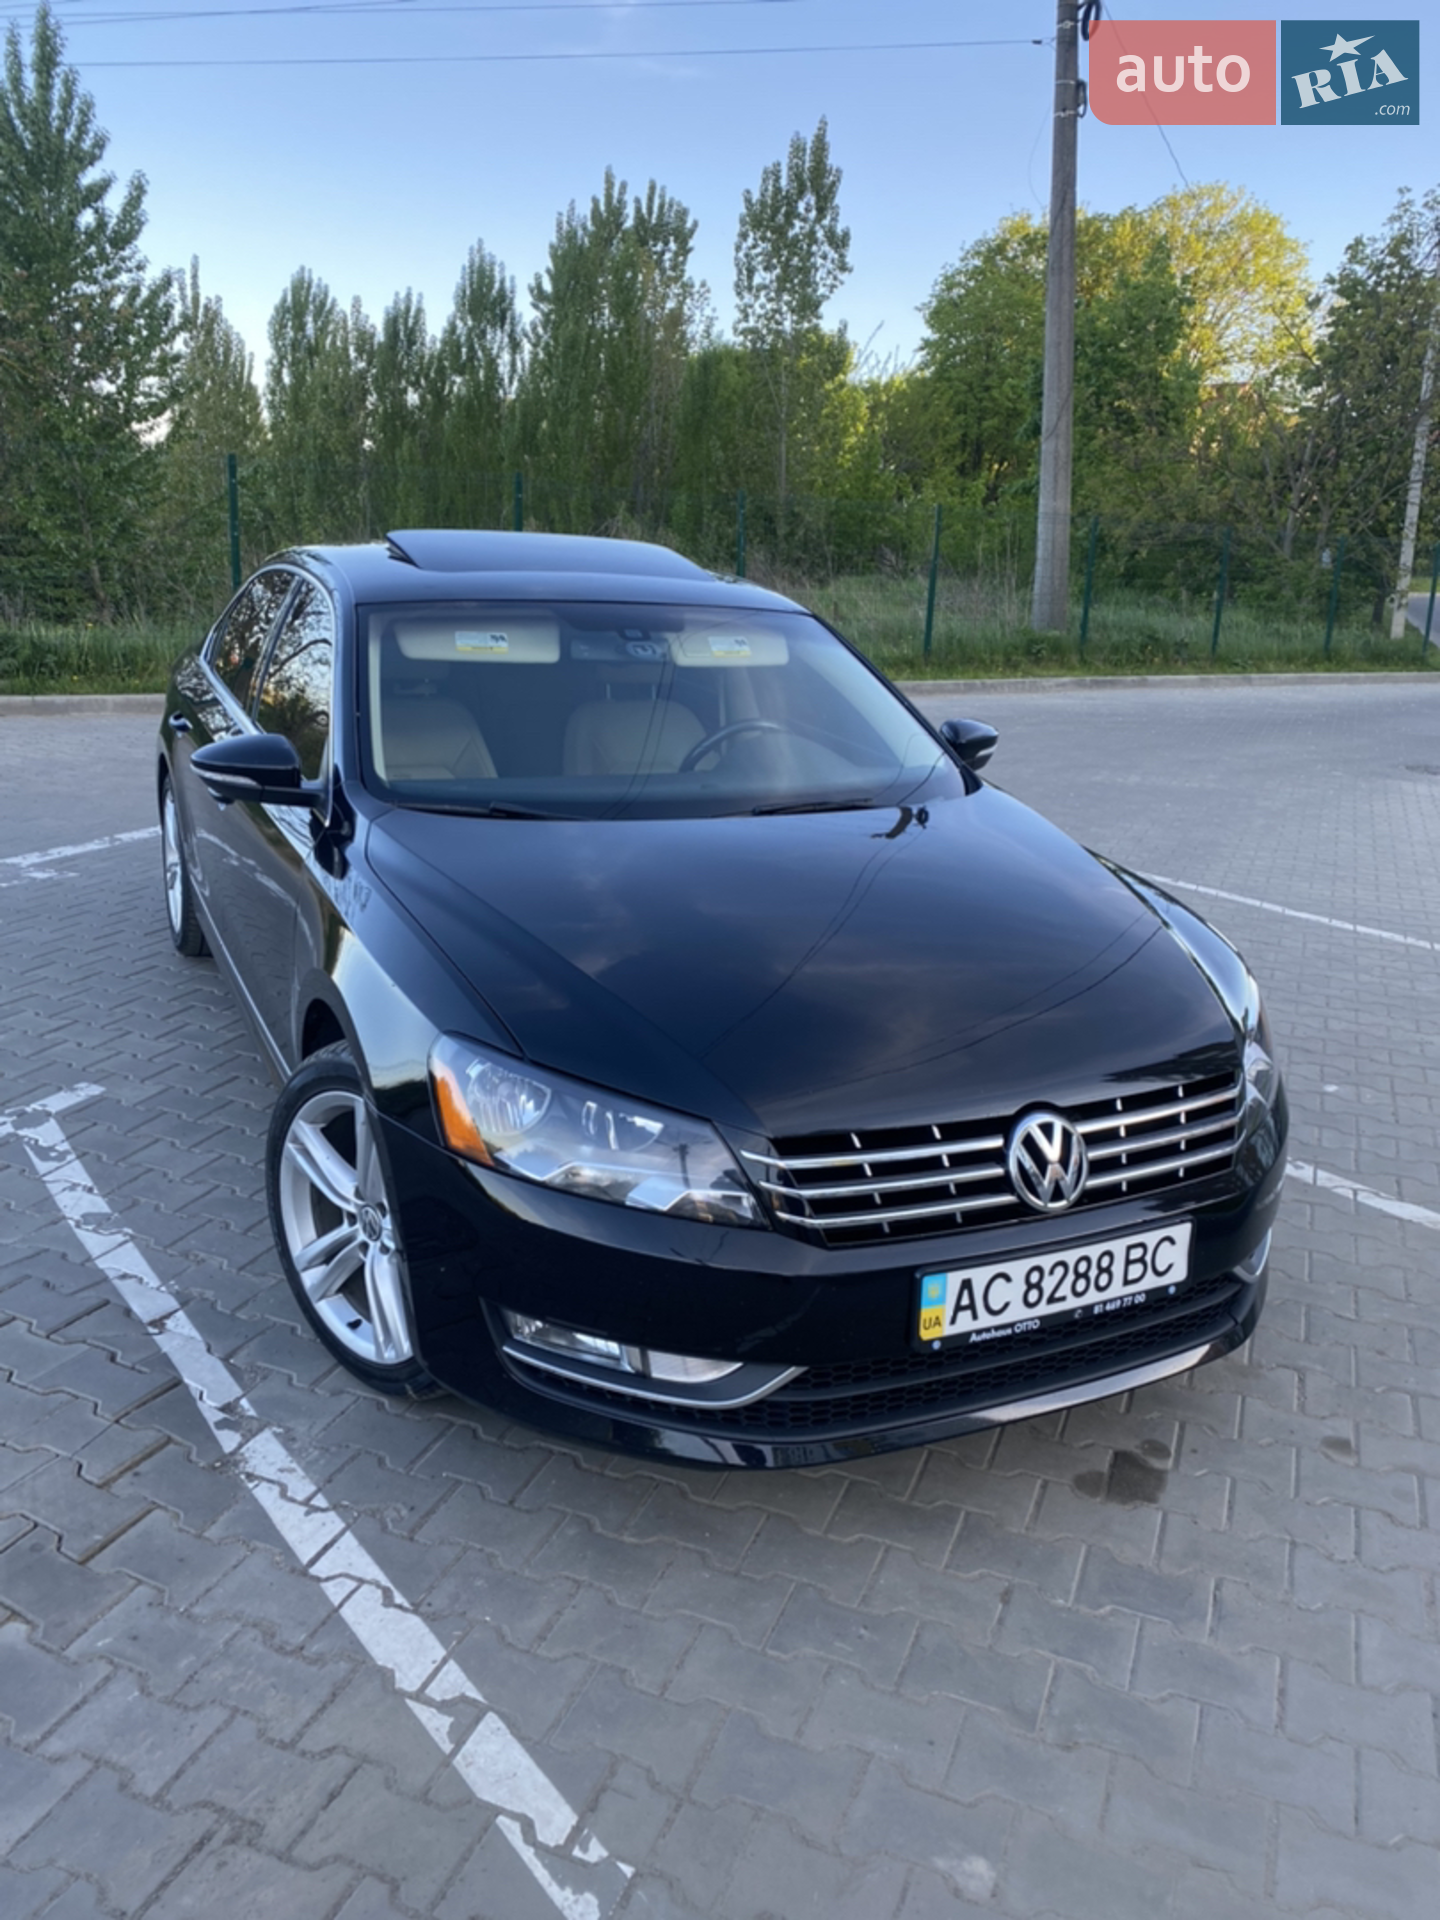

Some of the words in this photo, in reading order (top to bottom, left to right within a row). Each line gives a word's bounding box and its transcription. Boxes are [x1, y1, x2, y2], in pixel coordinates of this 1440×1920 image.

[949, 1271, 1013, 1326] AC
[1021, 1249, 1115, 1310] 8288
[1121, 1235, 1177, 1288] BC
[922, 1315, 942, 1331] UA
[968, 1327, 1013, 1343] Autohaus
[1013, 1319, 1041, 1334] OTTO
